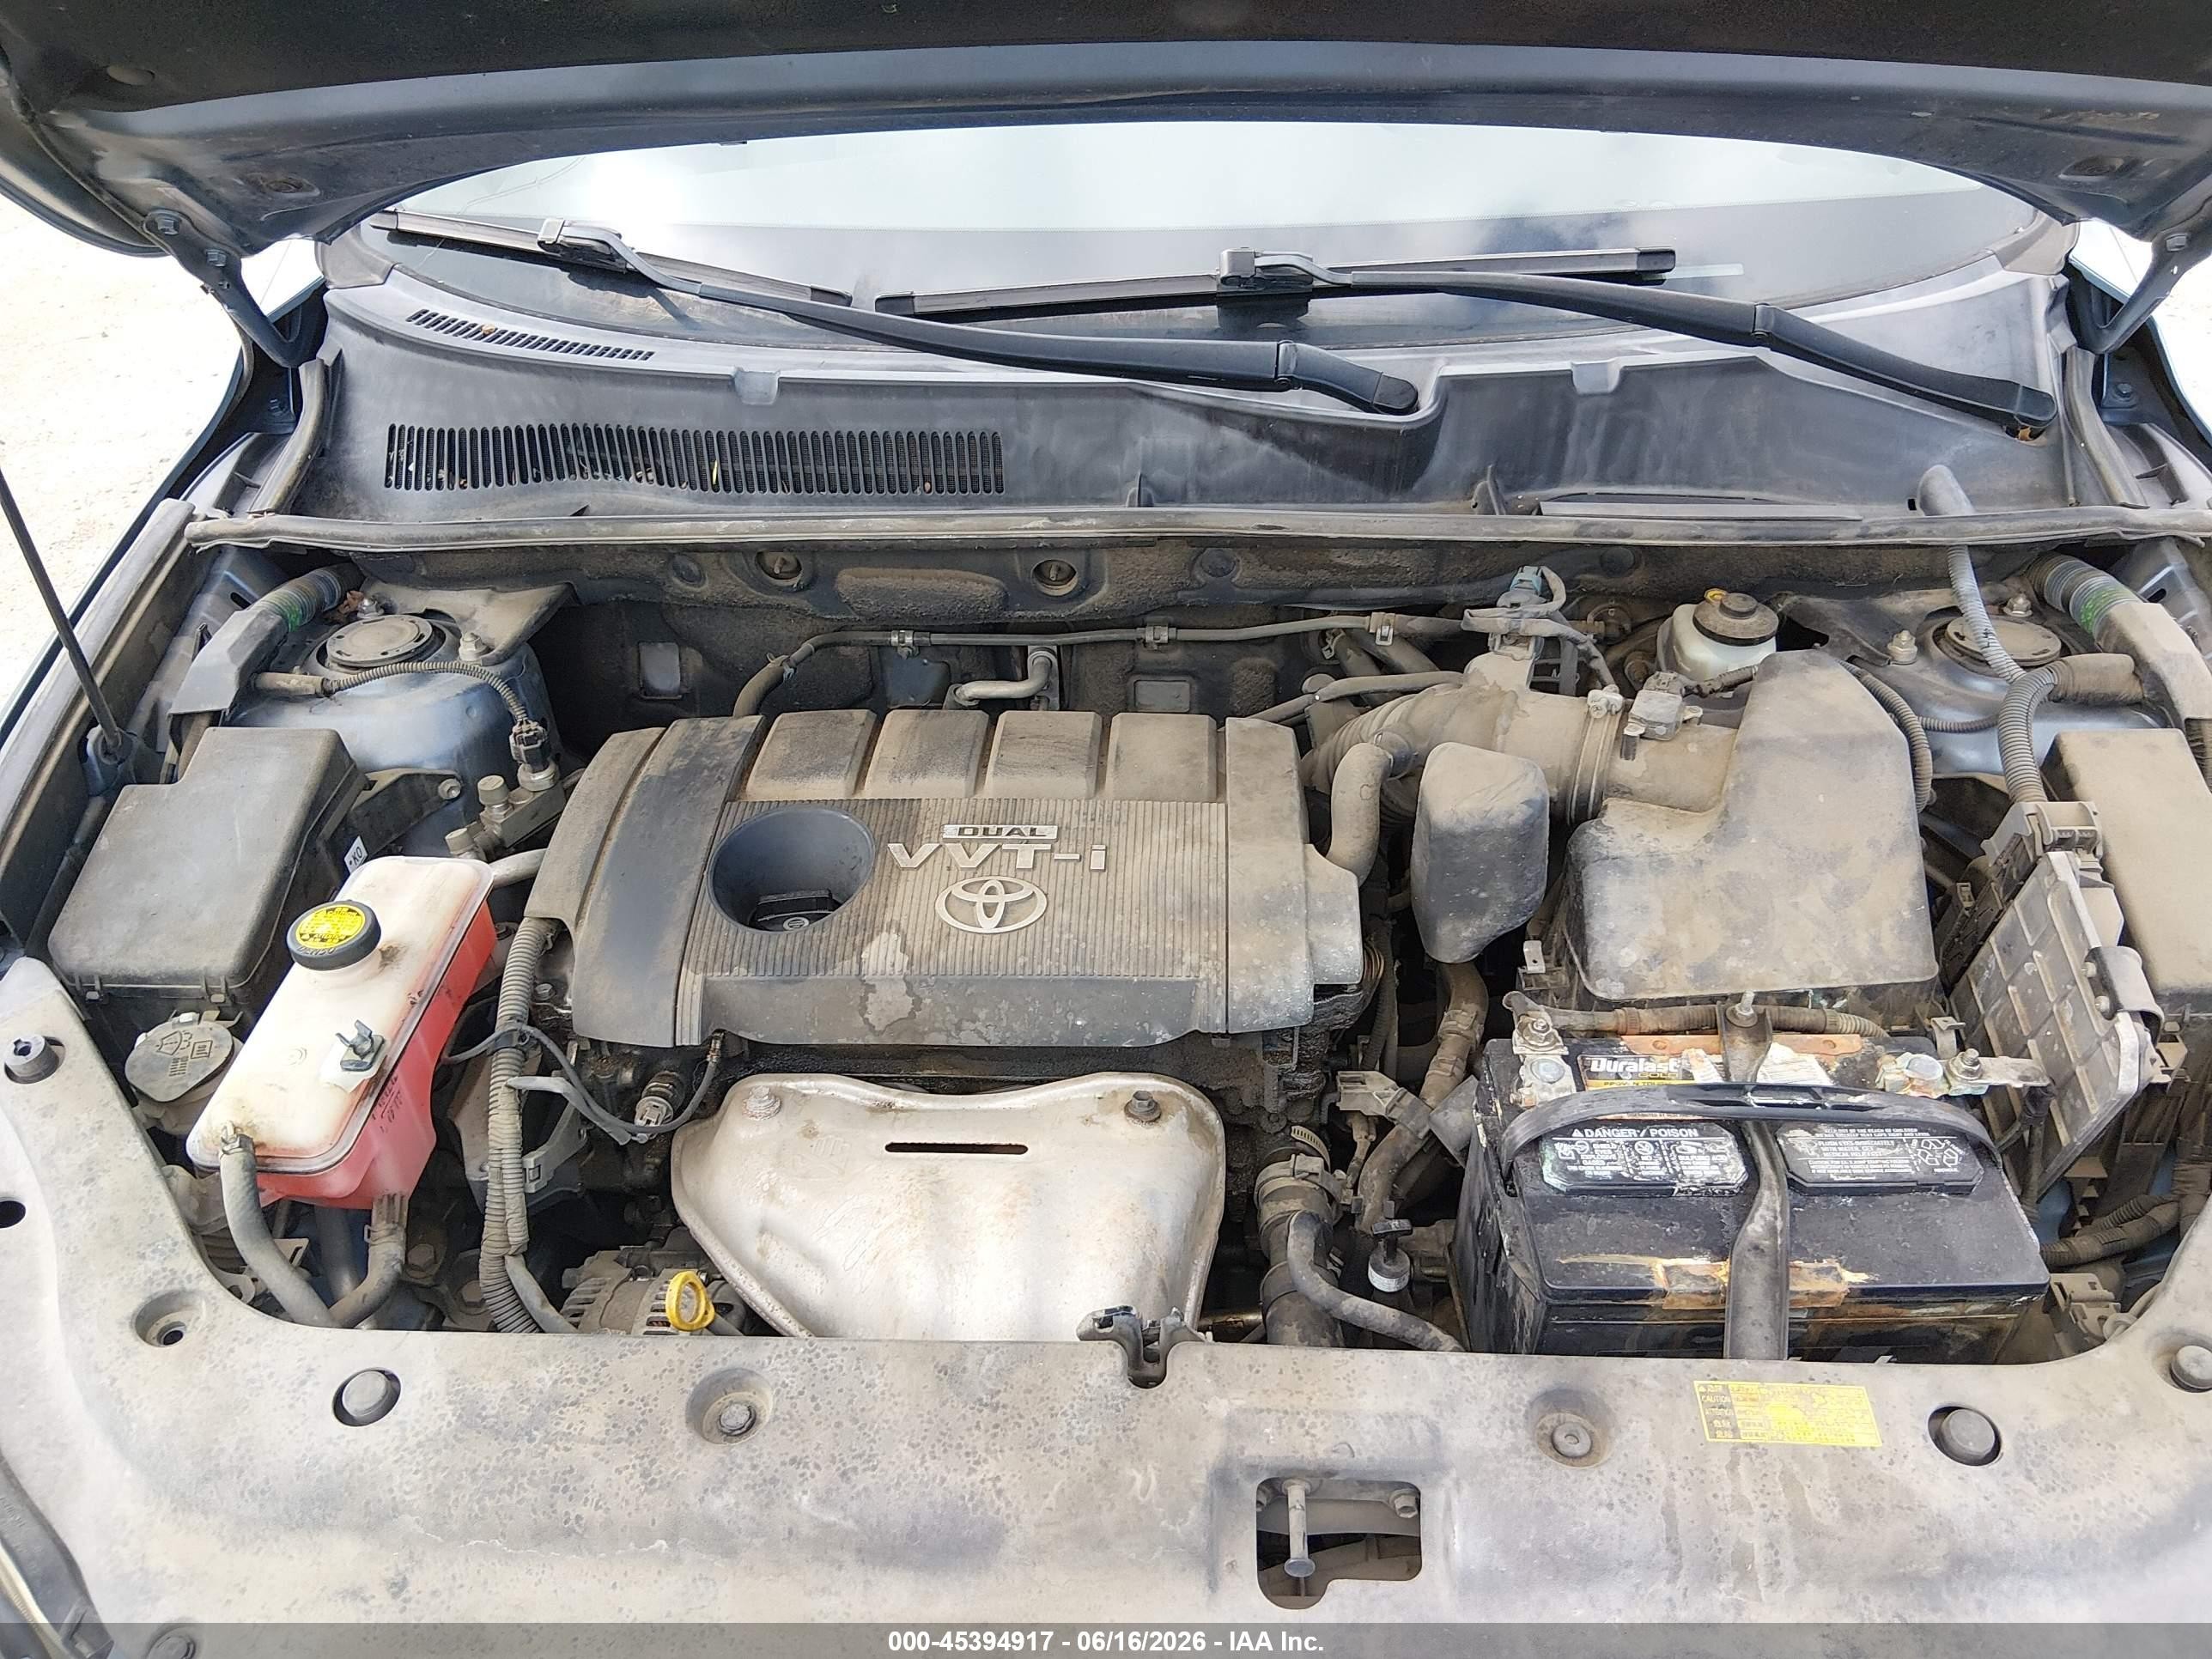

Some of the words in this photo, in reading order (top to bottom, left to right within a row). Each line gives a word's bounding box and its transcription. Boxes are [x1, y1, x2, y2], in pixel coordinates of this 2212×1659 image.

[957, 826, 1048, 837] DUAL
[887, 842, 1107, 872] VVT-i
[296, 946, 337, 956] DENSO
[1587, 1057, 1680, 1072] Duralast
[1584, 1128, 1637, 1138] DANGER
[1650, 1128, 1698, 1138] POISON
